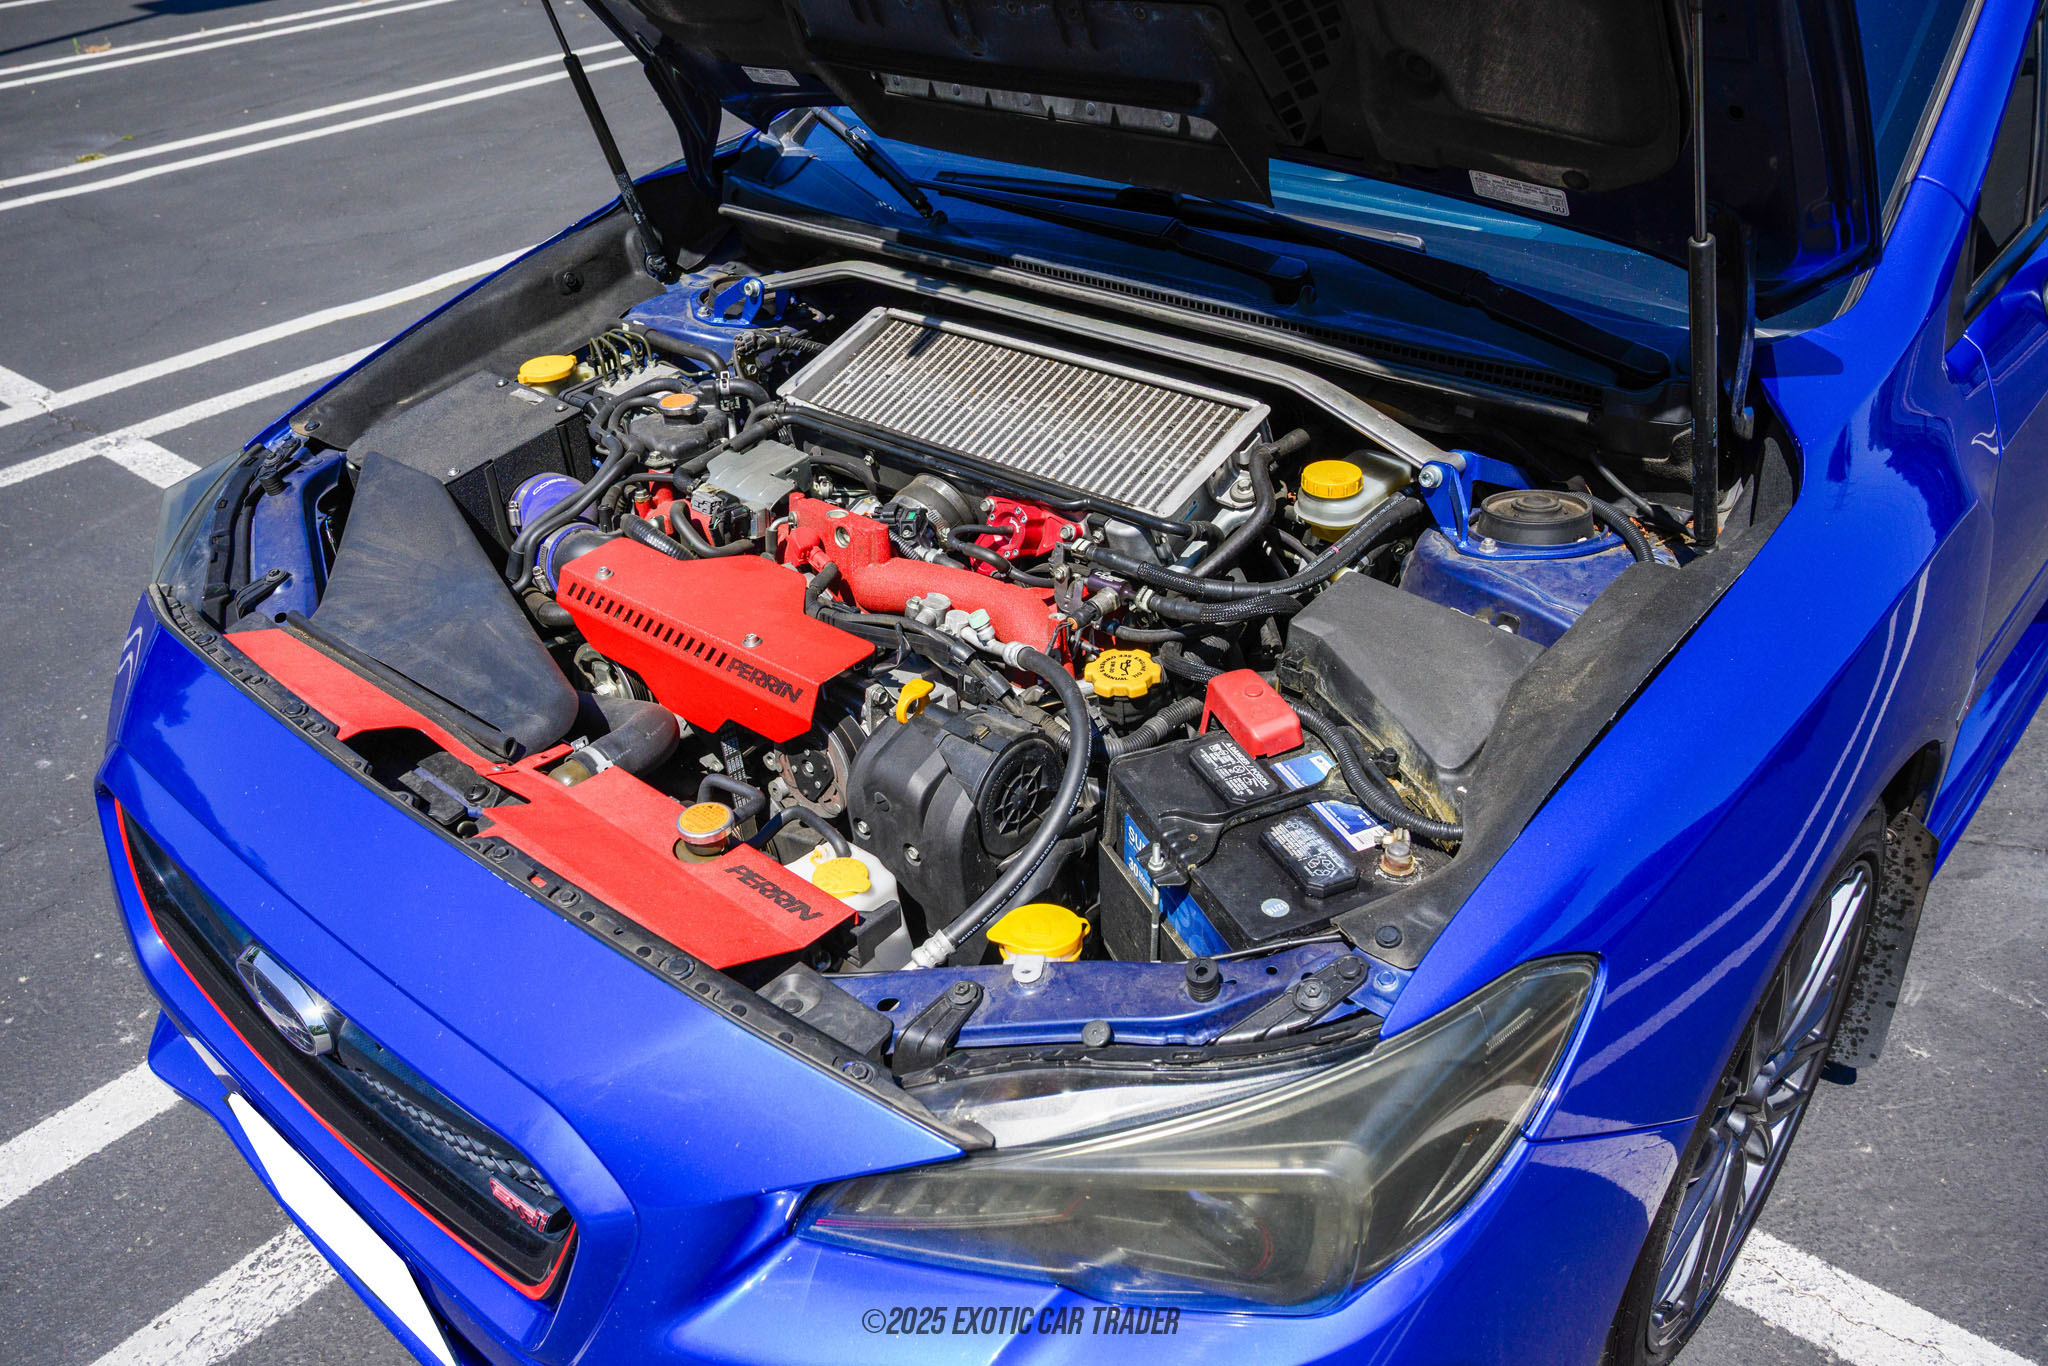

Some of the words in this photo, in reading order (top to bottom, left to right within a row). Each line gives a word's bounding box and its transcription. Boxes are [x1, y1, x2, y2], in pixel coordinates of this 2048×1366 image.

[726, 657, 803, 703] PERRIN
[1229, 746, 1250, 765] DANGER
[1250, 767, 1270, 786] POISON
[1128, 825, 1146, 850] SU
[724, 864, 824, 921] PERRIN
